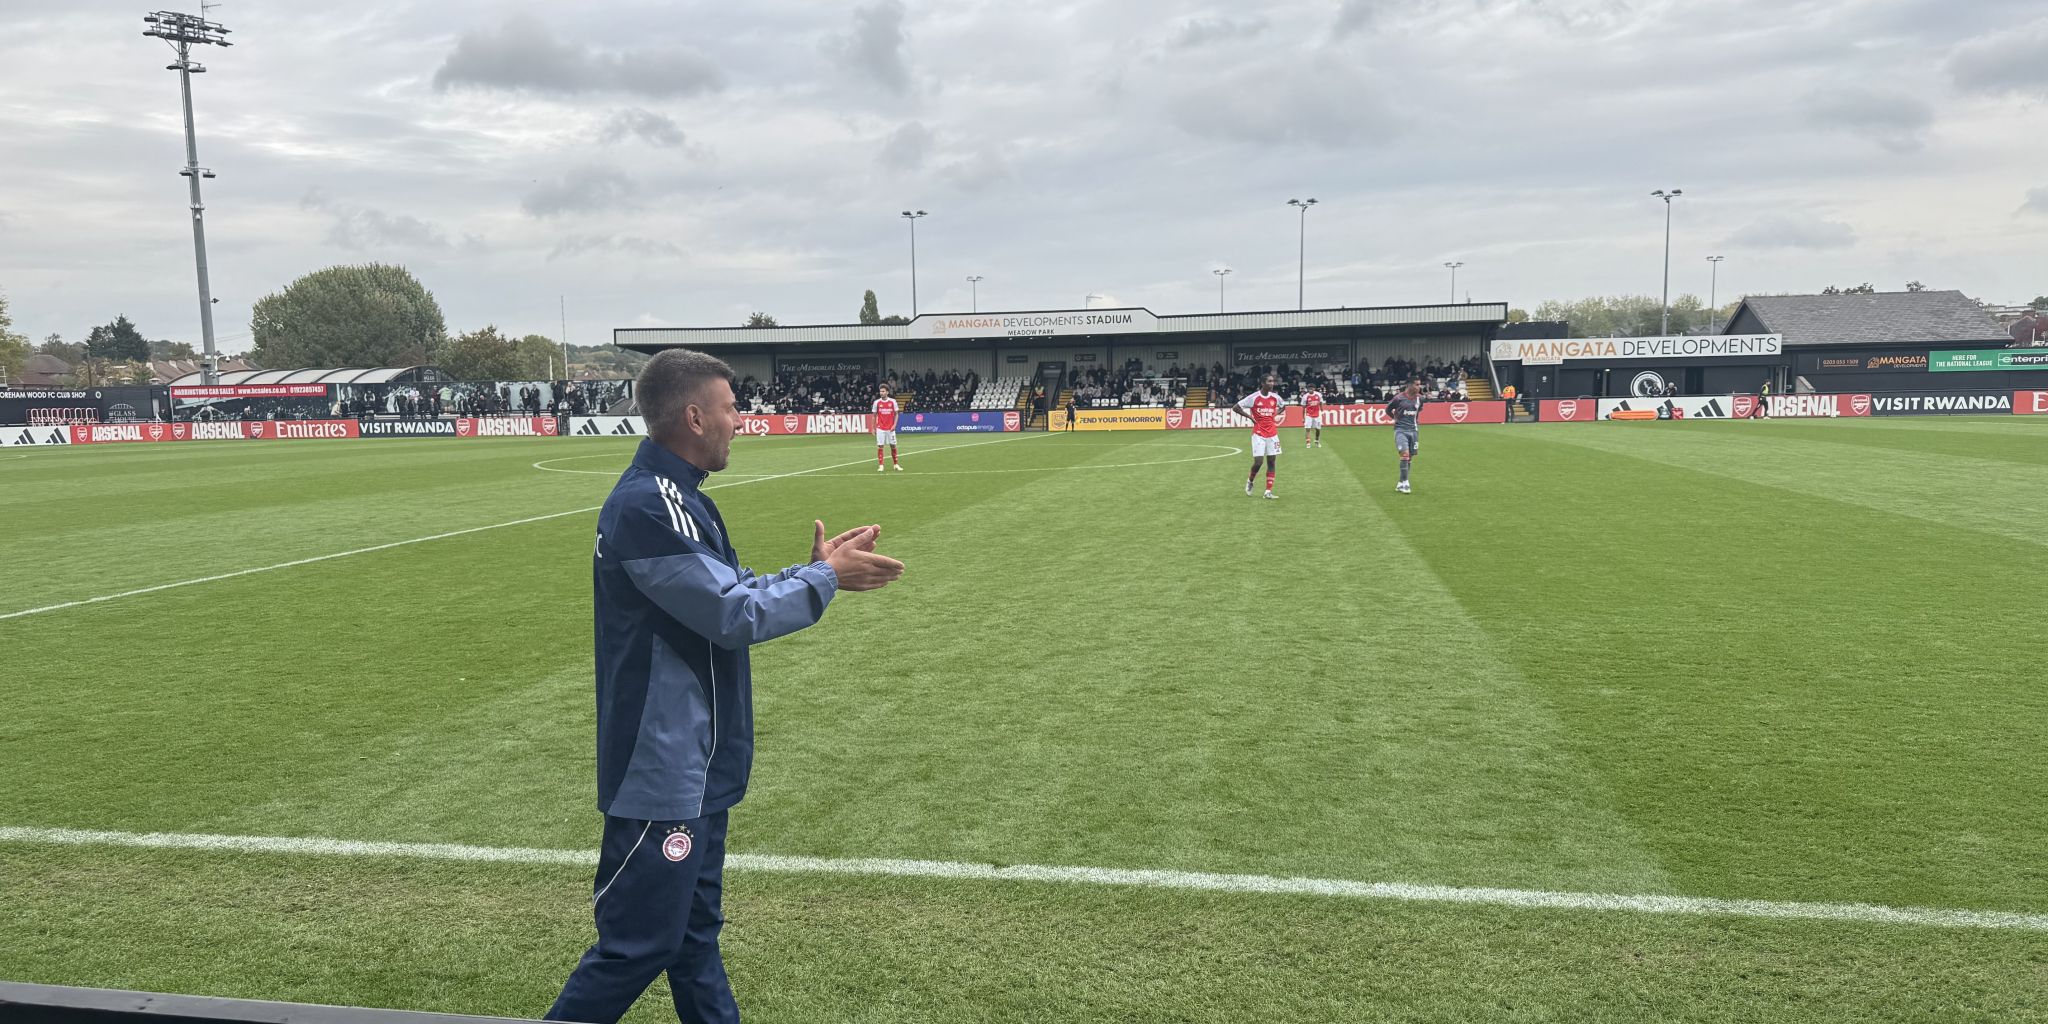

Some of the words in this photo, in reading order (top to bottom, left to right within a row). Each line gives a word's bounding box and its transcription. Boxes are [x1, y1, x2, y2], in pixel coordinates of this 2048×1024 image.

[948, 318, 1001, 328] MANGATA
[1003, 316, 1084, 328] DEVELOPMENTS
[1086, 314, 1132, 325] STADIUM
[1238, 352, 1253, 360] THE
[1255, 351, 1299, 360] MEMORIAL
[1300, 350, 1328, 359] STAND
[1517, 342, 1617, 357] MANGATA
[1622, 337, 1778, 356] DEVELOPMENTS
[1880, 356, 1927, 364] MANGATA
[1761, 396, 1840, 416] ARSENAL
[1873, 397, 1920, 410] VISIT
[1924, 396, 2011, 410] RWANDA
[478, 418, 535, 436] ARSENAL
[806, 414, 868, 433] ARSENAL
[1191, 408, 1255, 428] ARSENA
[92, 426, 143, 442] ARSENAL
[192, 422, 245, 440] ARSENAL
[276, 420, 346, 438] Emirates
[360, 423, 393, 434] VISIT
[394, 422, 454, 434] RWANDA
